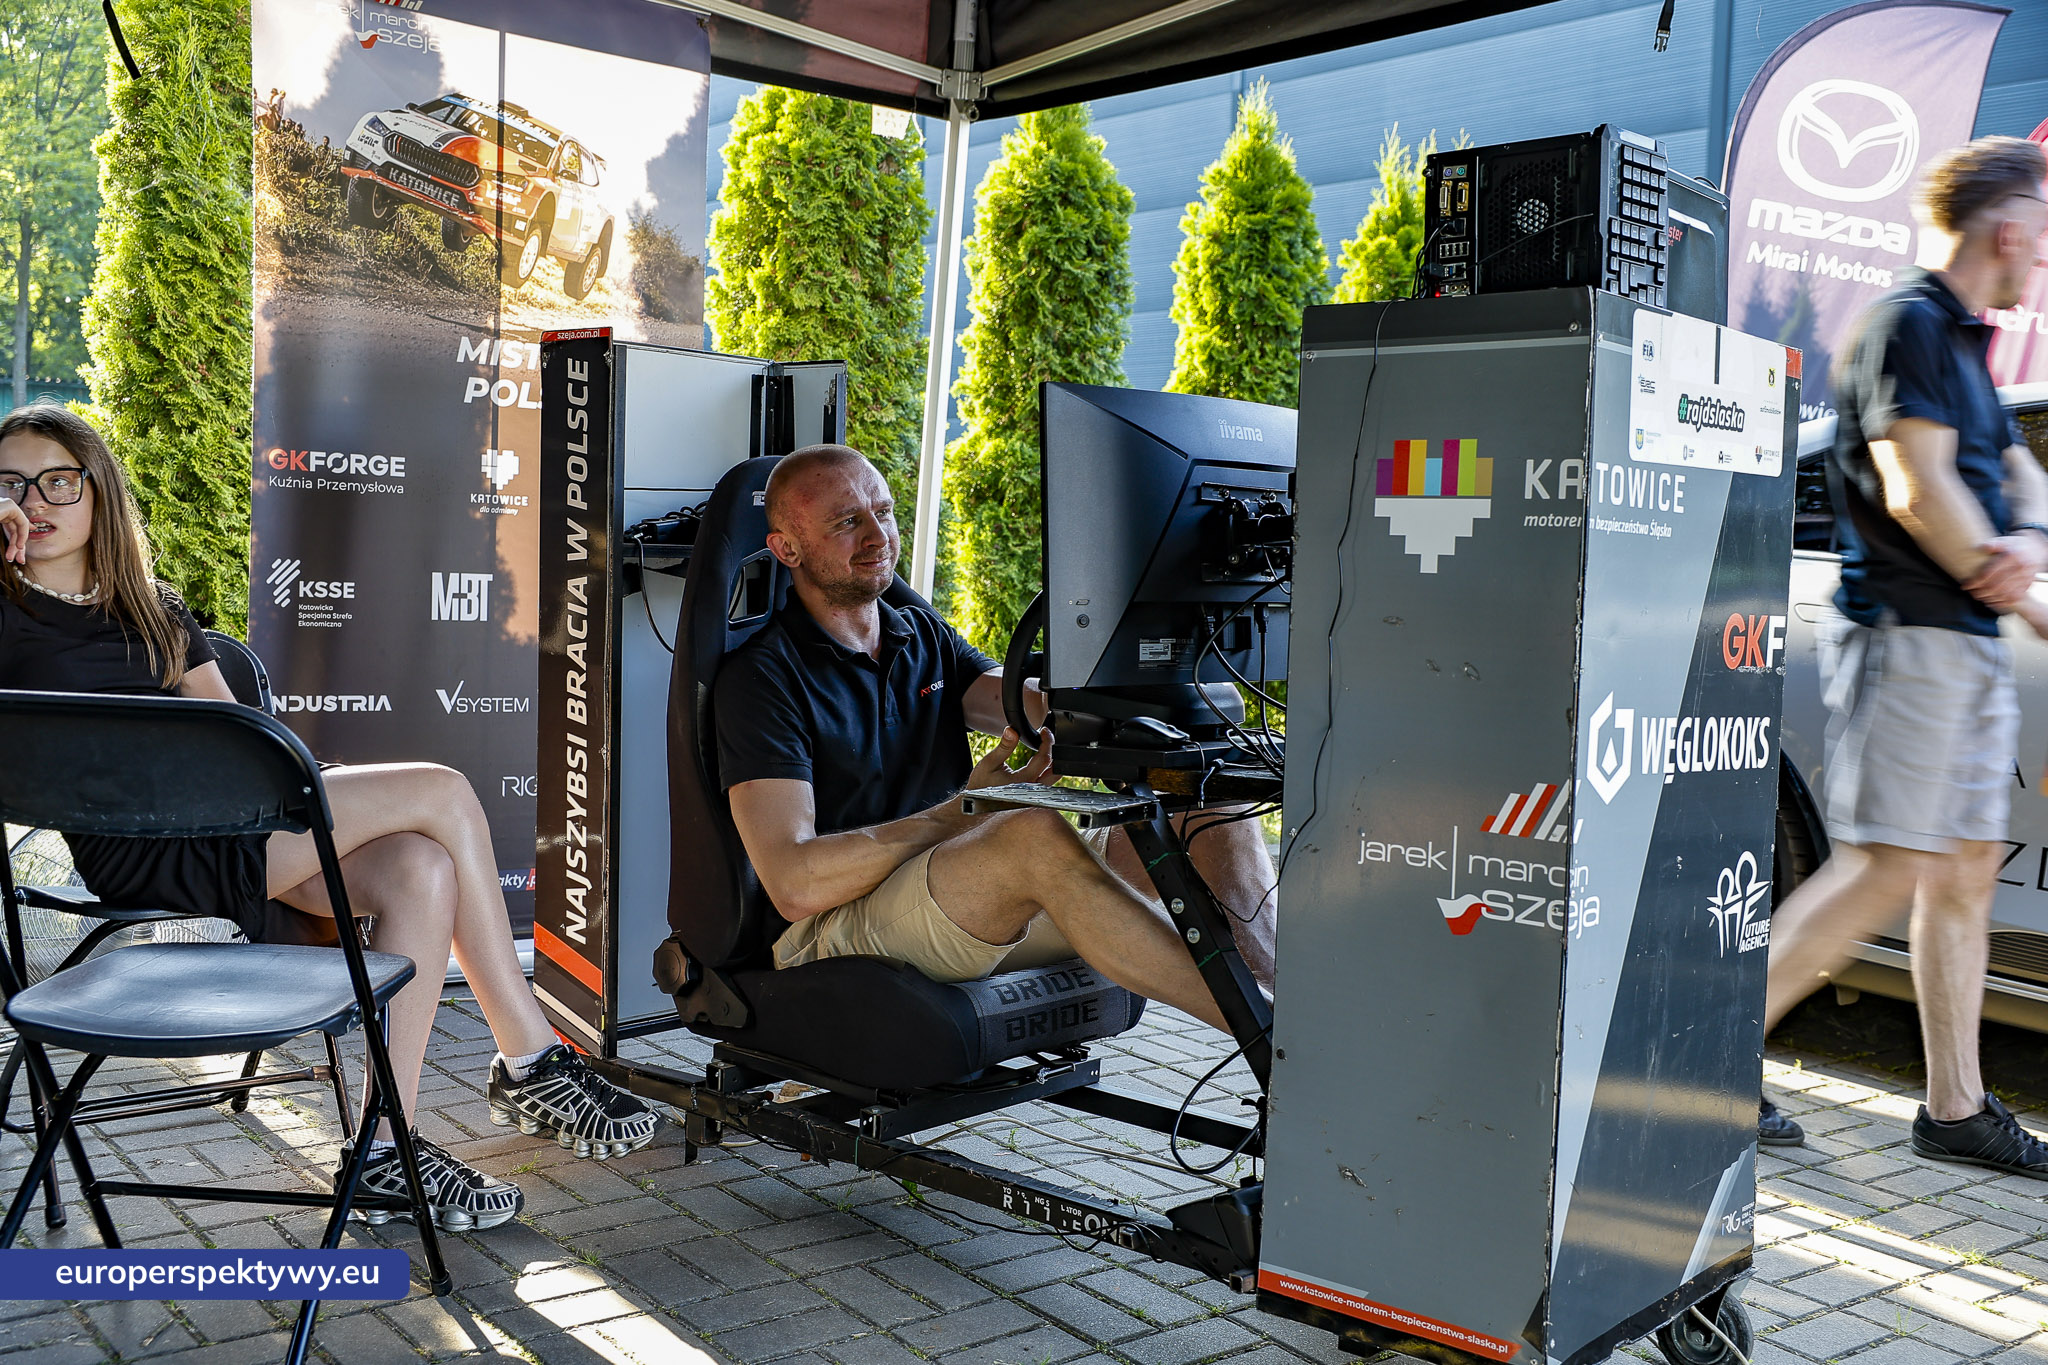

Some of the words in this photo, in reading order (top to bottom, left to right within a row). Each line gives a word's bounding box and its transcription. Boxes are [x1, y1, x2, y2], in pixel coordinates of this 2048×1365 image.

[376, 27, 442, 54] szeja
[388, 167, 461, 209] KATOWICE
[1746, 240, 1810, 273] Mirai
[1812, 251, 1894, 289] Motors
[556, 329, 600, 341] szeja.com.pl
[463, 376, 543, 410] POL
[1217, 418, 1264, 443] iiyama
[1678, 394, 1745, 433] #rajdslaska
[566, 357, 589, 511] POLSCE
[268, 447, 406, 478] GKFORGE
[268, 475, 313, 490] Kuźnia
[317, 477, 404, 495] Przemysłowa
[470, 493, 529, 507] KATOWICE
[566, 517, 588, 562] W
[298, 580, 356, 600] KSSE
[298, 603, 334, 611] Katowicka
[298, 611, 331, 621] Specjalna
[332, 612, 353, 620] Strefa
[298, 620, 342, 628] Ekonomiczna
[566, 575, 588, 726] BRACIA
[1722, 612, 1787, 670] GKF
[271, 694, 393, 713] NDUSTRIA
[1641, 716, 1771, 785] WĘGLOKOKS
[565, 732, 593, 945] NAJSZYBSI
[1357, 832, 1448, 872] jarek
[1480, 888, 1601, 940] szeja
[989, 966, 1095, 1006] BRIDE
[1004, 998, 1099, 1043] BRIDE
